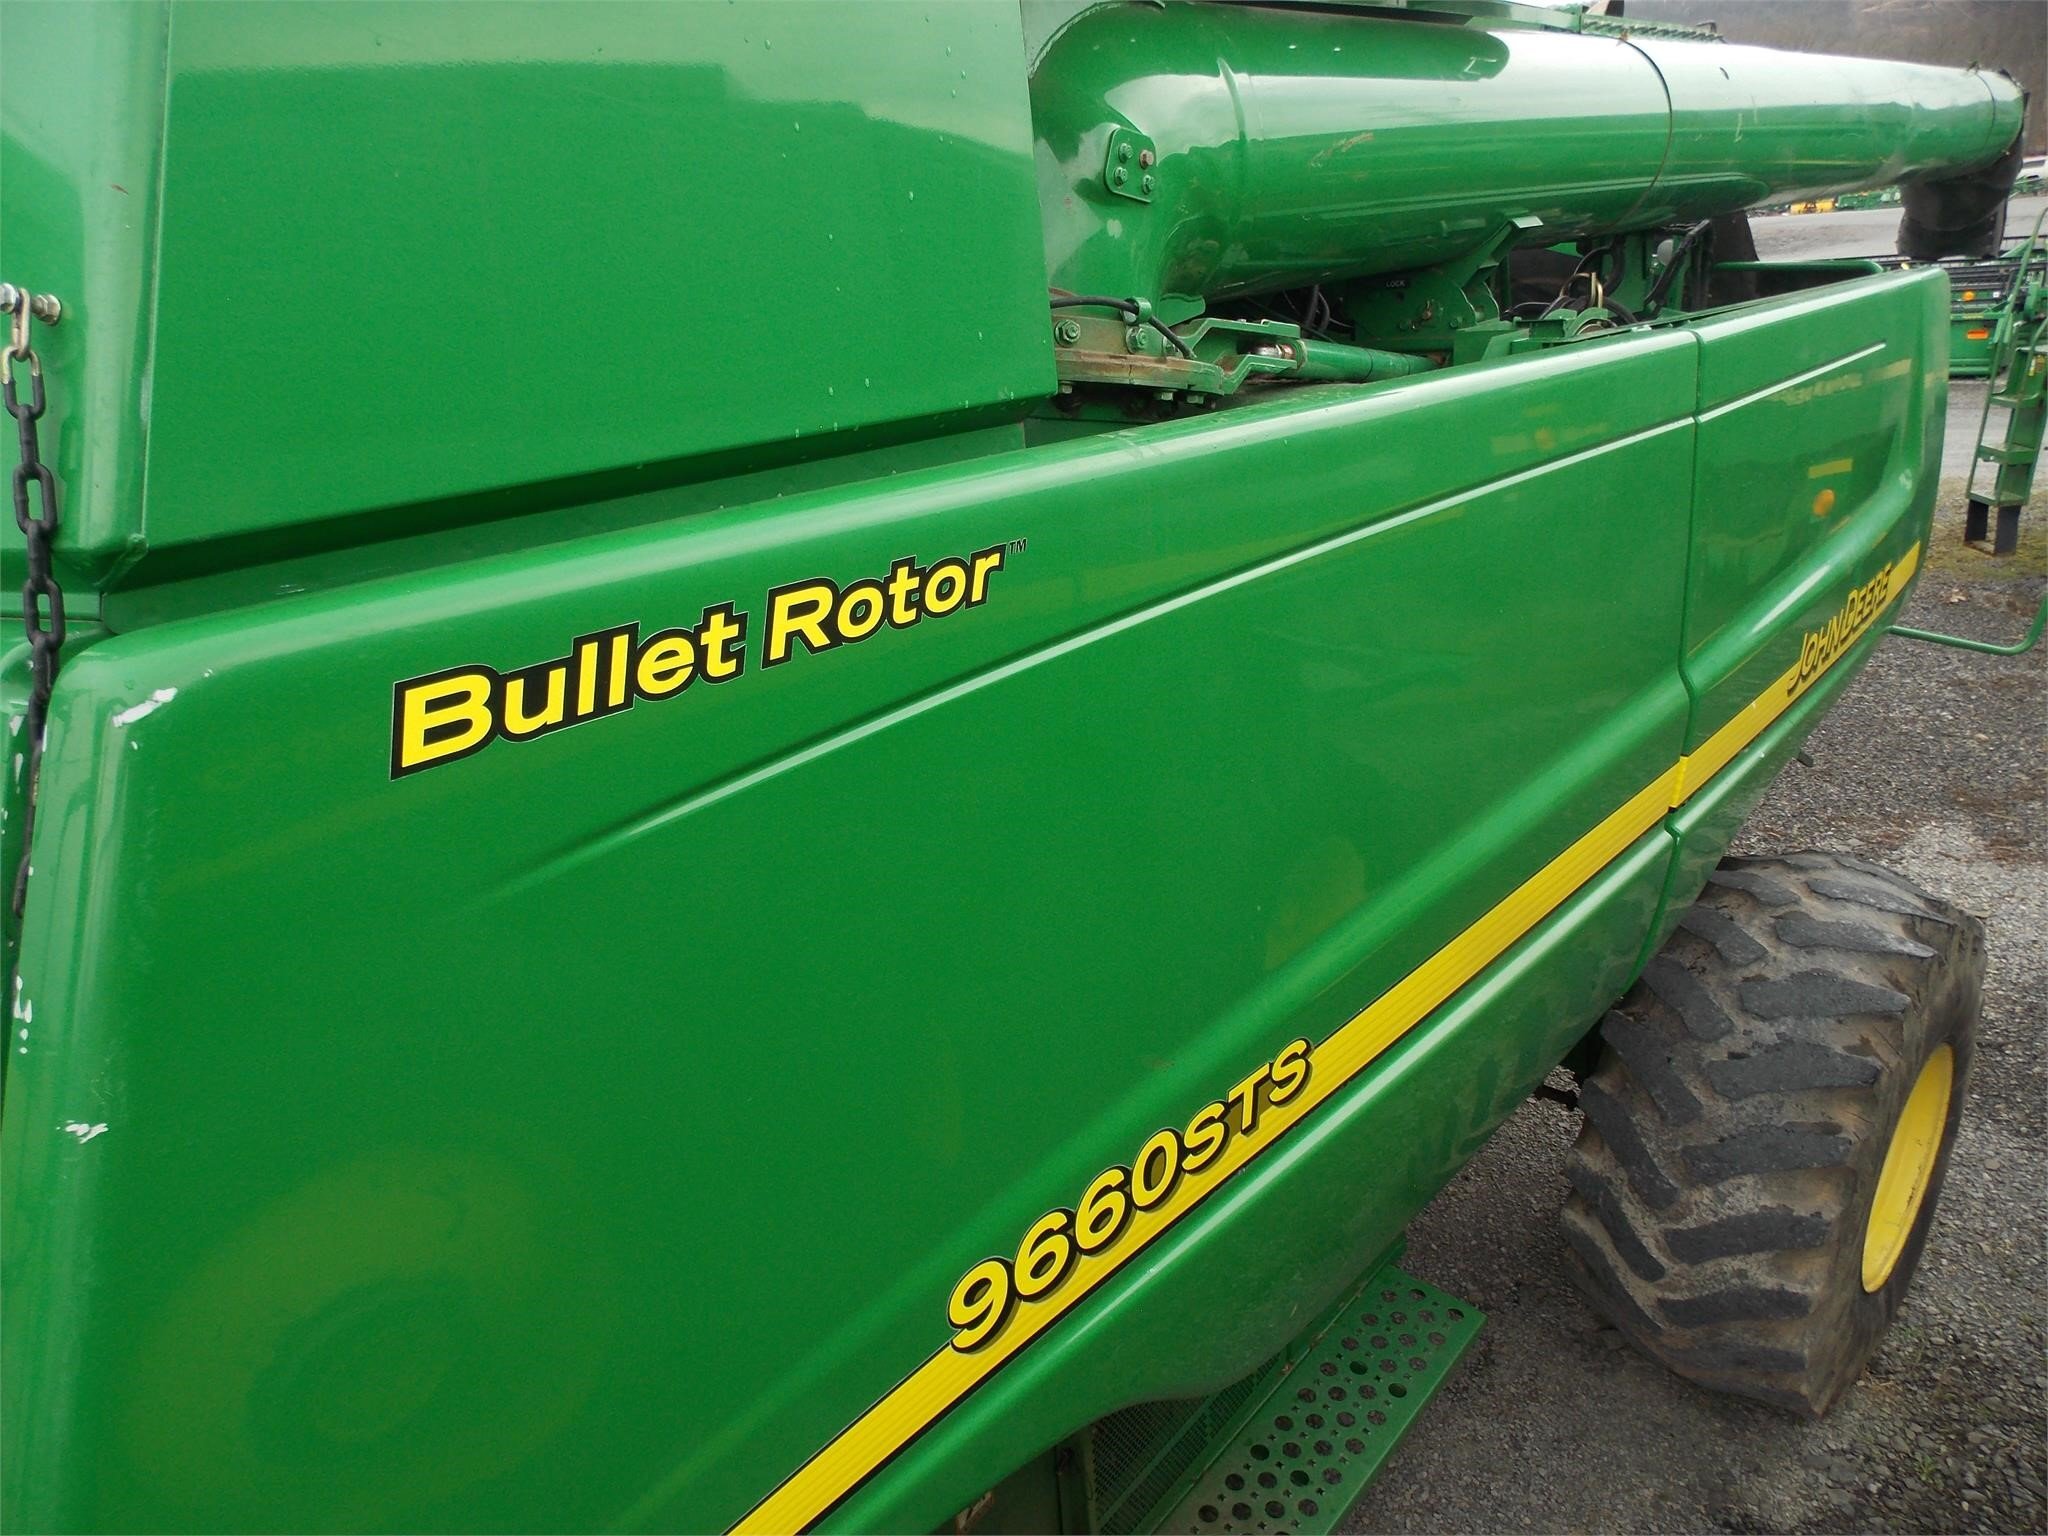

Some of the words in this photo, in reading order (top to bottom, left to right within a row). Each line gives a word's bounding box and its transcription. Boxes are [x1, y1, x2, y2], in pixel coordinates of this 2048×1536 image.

[396, 606, 744, 774] Bullet
[765, 548, 1003, 666] Rotor
[1786, 607, 1846, 697] JOHN
[1839, 561, 1894, 643] DEERE
